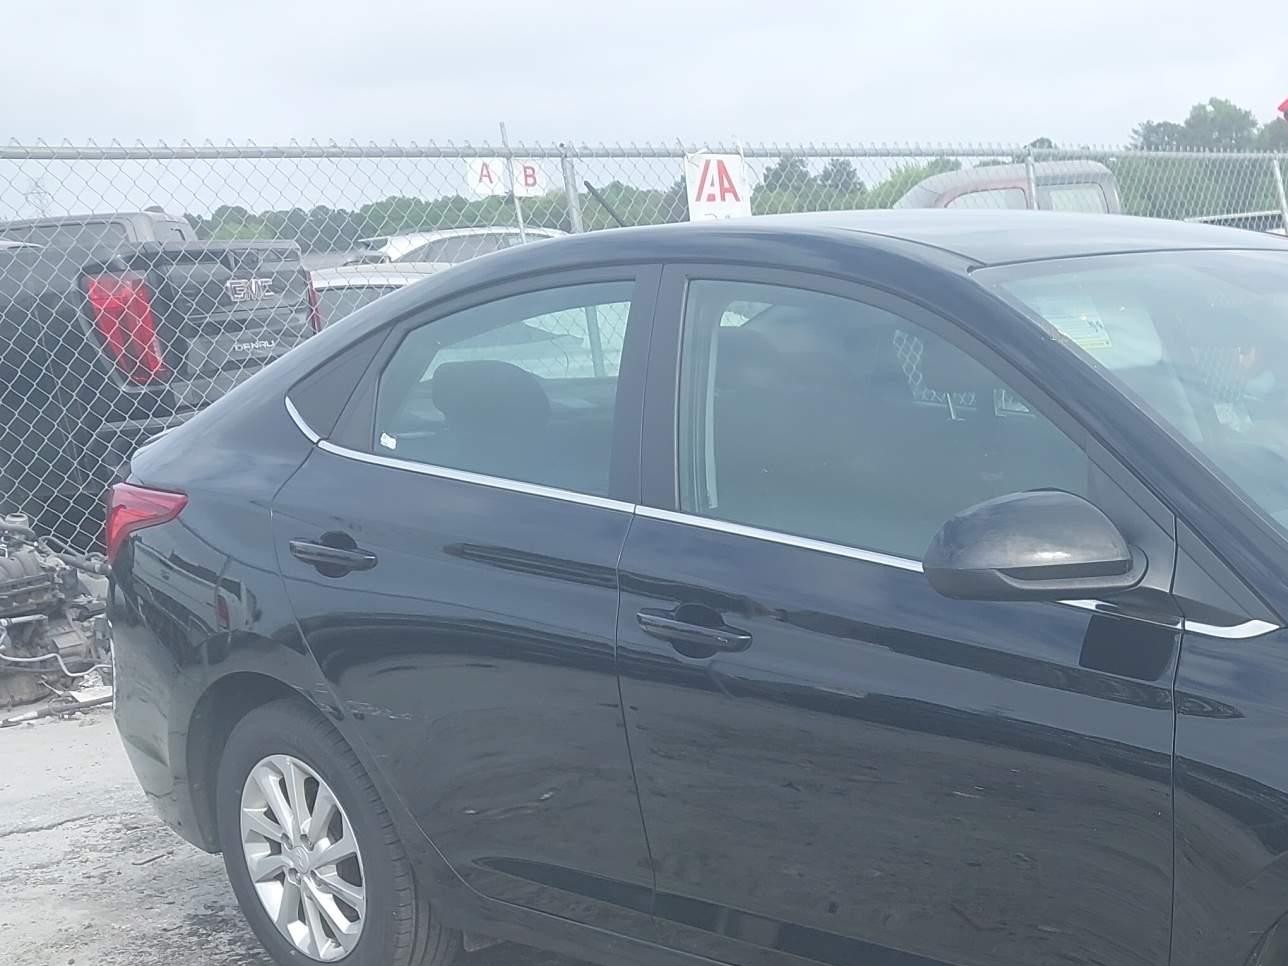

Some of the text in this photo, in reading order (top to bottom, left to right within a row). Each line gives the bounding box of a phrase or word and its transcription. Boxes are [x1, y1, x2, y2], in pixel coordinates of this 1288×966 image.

[478, 161, 493, 184] A
[523, 165, 537, 188] B
[226, 277, 275, 302] GMC
